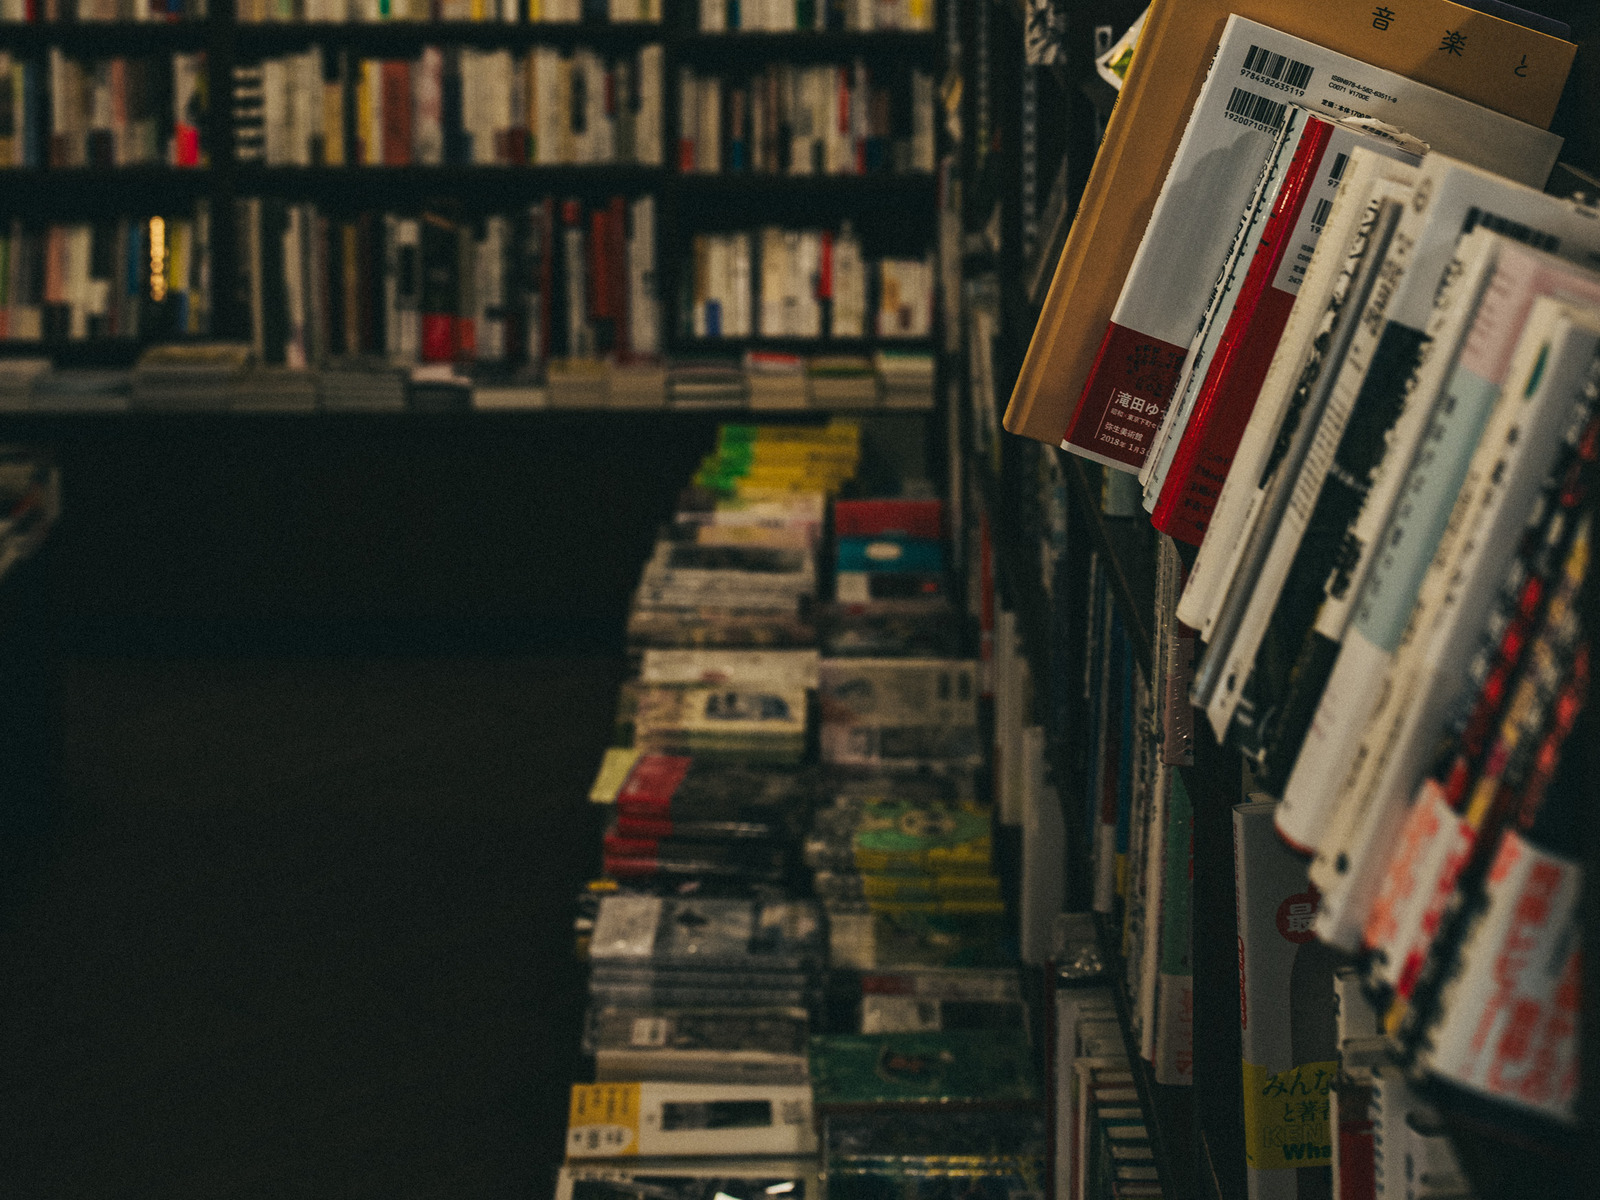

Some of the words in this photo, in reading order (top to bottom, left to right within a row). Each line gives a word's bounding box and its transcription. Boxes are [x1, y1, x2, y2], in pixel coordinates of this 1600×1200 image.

[1240, 68, 1305, 97] 9784582635119
[1328, 82, 1346, 93] C0071
[1115, 391, 1164, 415] 滝田ゆ
[1105, 422, 1143, 442] 弥生美術館
